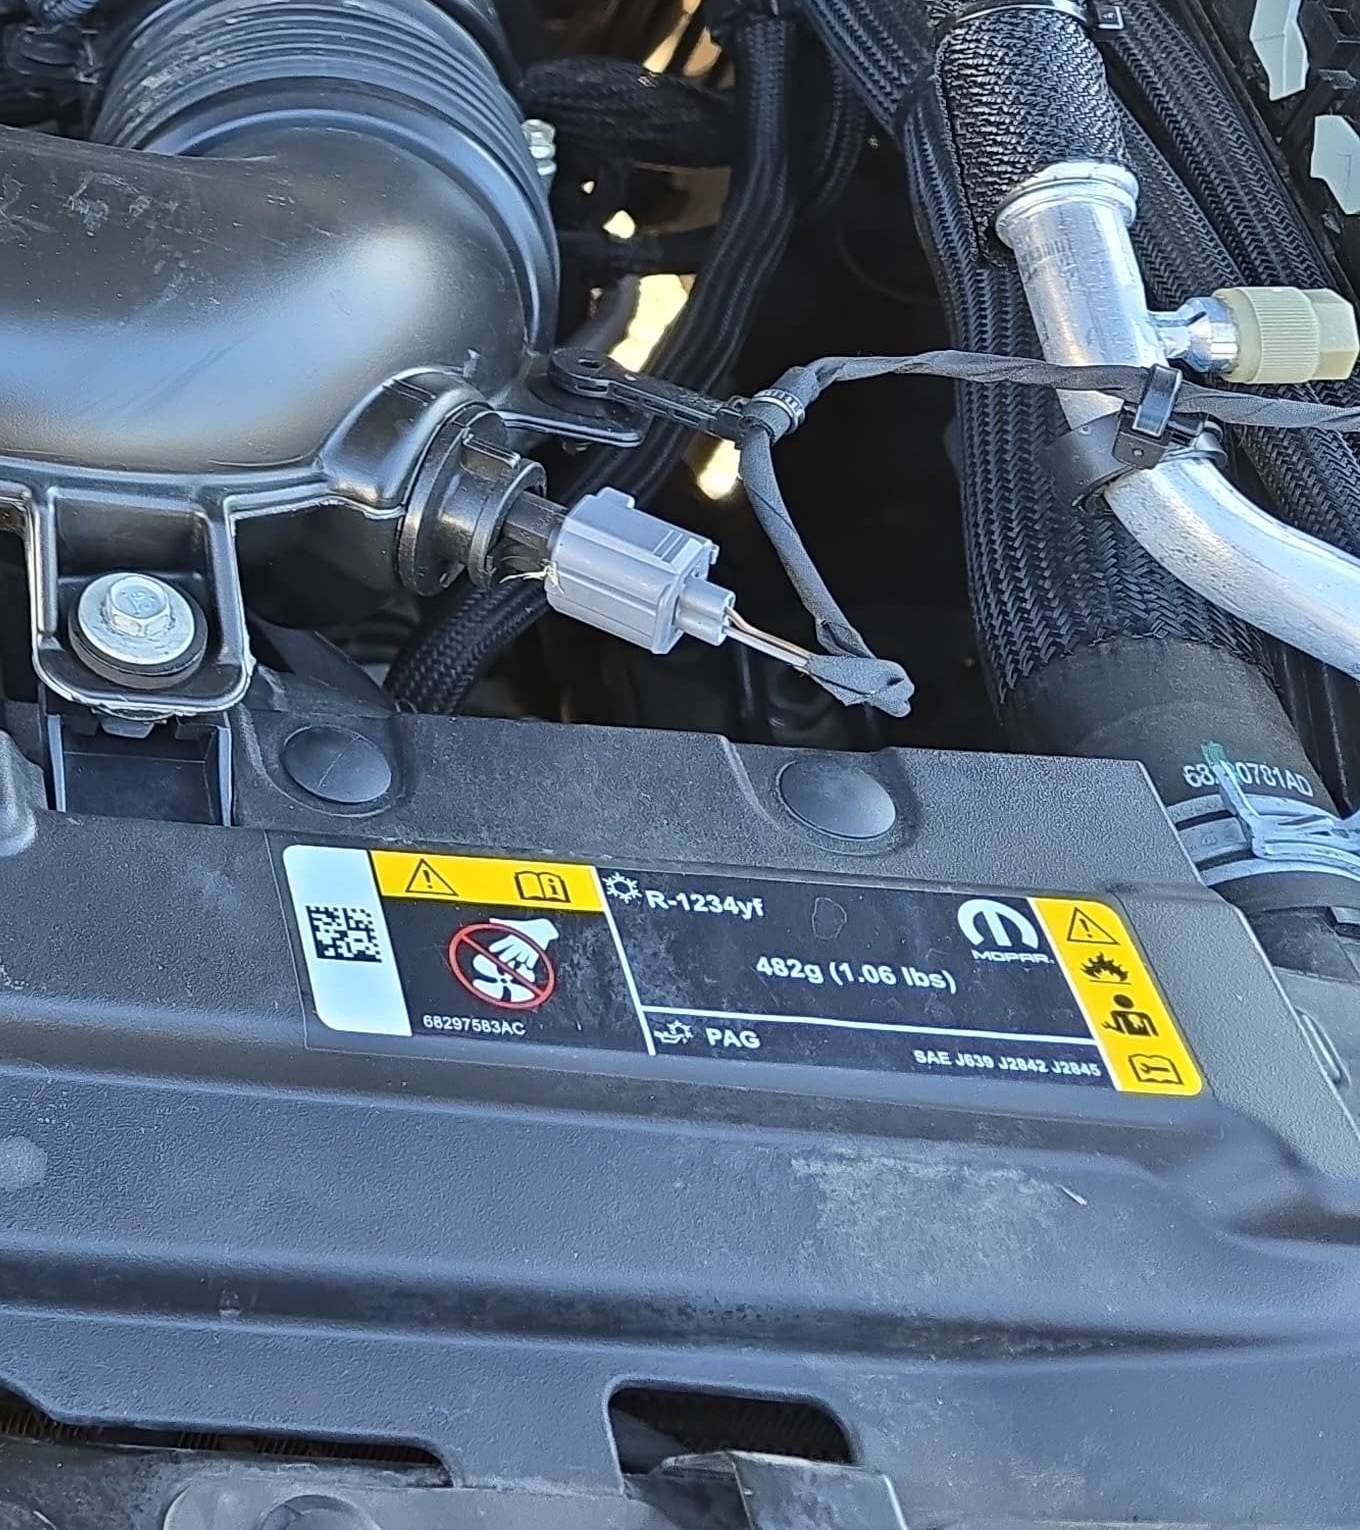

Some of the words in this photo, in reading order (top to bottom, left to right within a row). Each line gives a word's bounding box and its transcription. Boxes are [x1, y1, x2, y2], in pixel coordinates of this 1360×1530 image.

[1183, 761, 1314, 798] 680781AD
[645, 890, 765, 920] R-1234yf
[971, 949, 1049, 965] MOPAR
[755, 956, 824, 985] 482g
[829, 961, 897, 987] (1.06
[900, 966, 958, 995] lbs)
[423, 1014, 527, 1036] 68297583AC
[705, 1027, 761, 1050] PAG
[913, 1049, 953, 1066] SAE
[955, 1052, 995, 1069] J639
[998, 1056, 1048, 1073] J2842
[1051, 1060, 1102, 1077] J2845
